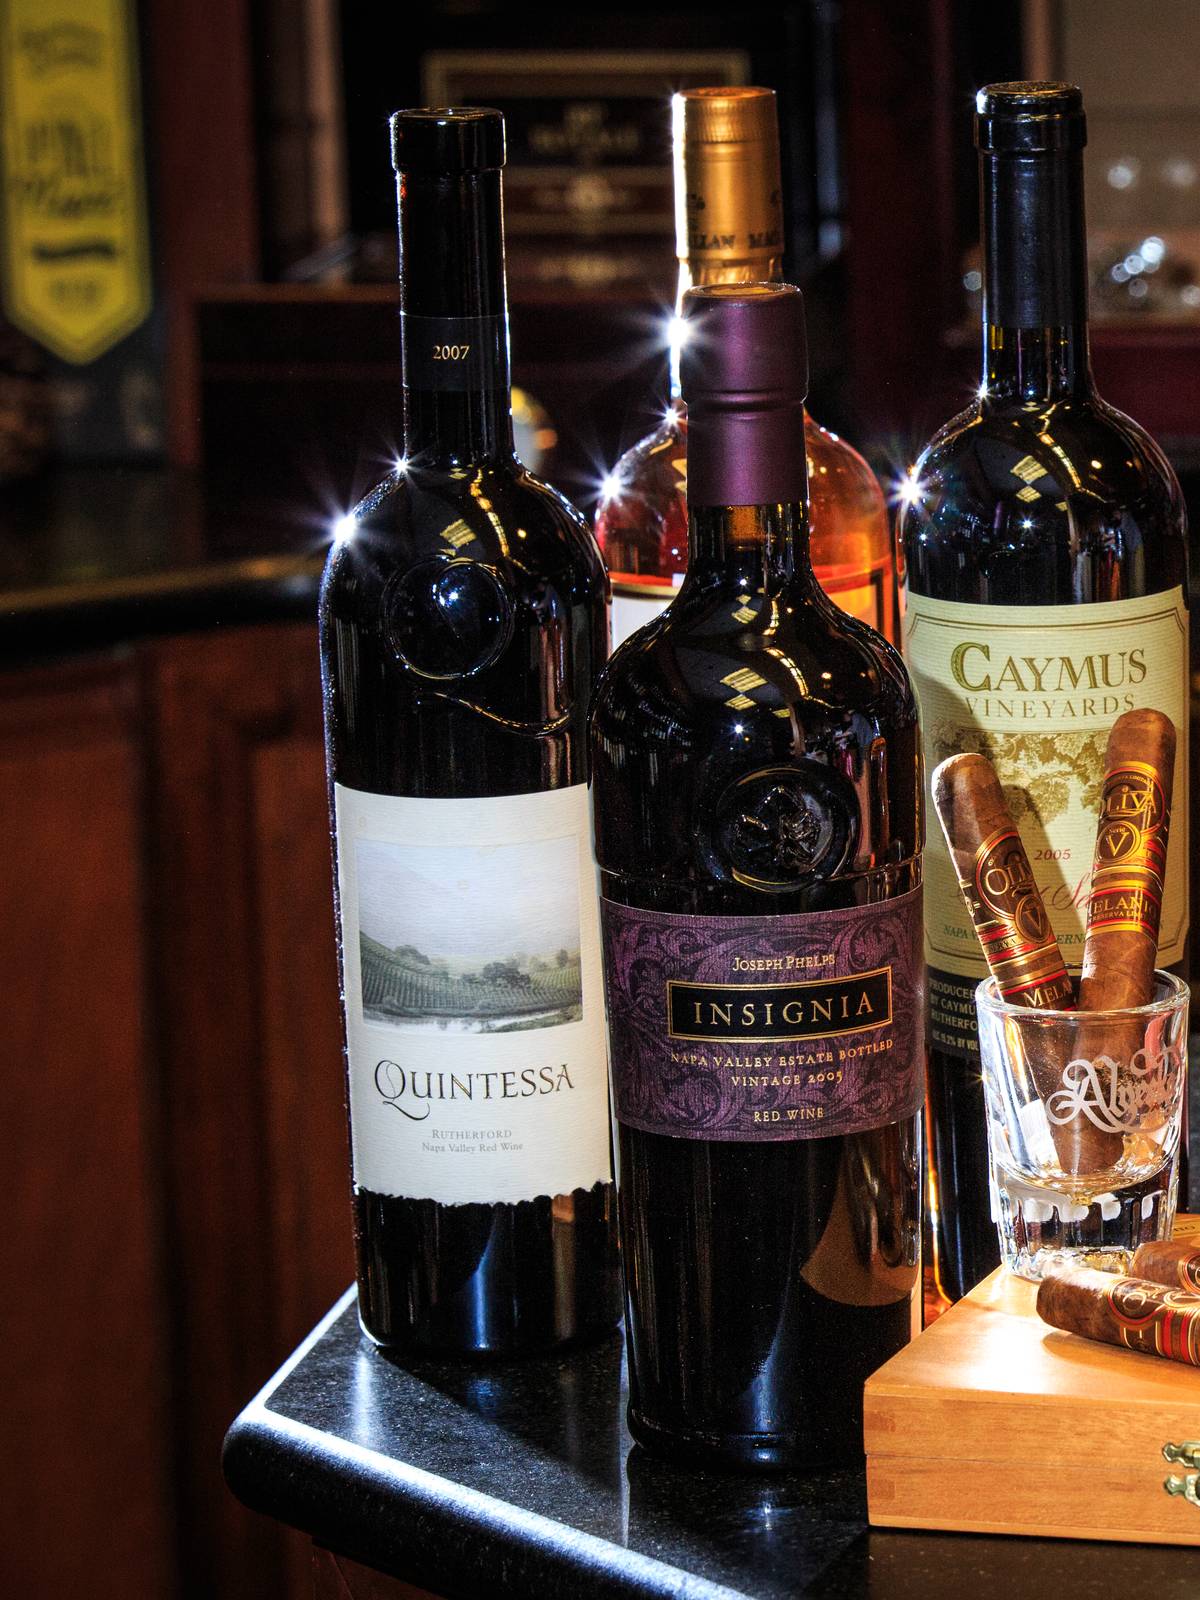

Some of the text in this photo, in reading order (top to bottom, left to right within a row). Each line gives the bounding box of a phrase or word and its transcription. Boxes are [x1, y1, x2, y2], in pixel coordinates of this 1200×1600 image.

[432, 345, 470, 360] 2007
[950, 641, 1148, 692] CAYMUS
[965, 693, 1135, 719] VINEYARDS
[1107, 832, 1130, 857] V
[1033, 848, 1072, 861] 2005
[732, 953, 836, 972] JOSEPH PHELPS
[693, 991, 874, 1026] INSIGNIA
[671, 1039, 894, 1068] NAPA VALLEY ESTATE BOTTLED
[731, 1070, 844, 1088] VINTAGE 2005
[374, 1059, 575, 1121] QUINTESSA
[753, 1106, 825, 1123] RED WINE
[432, 1128, 513, 1140] RUTHERFORD
[422, 1141, 524, 1155] Napa Valley Red Wine
